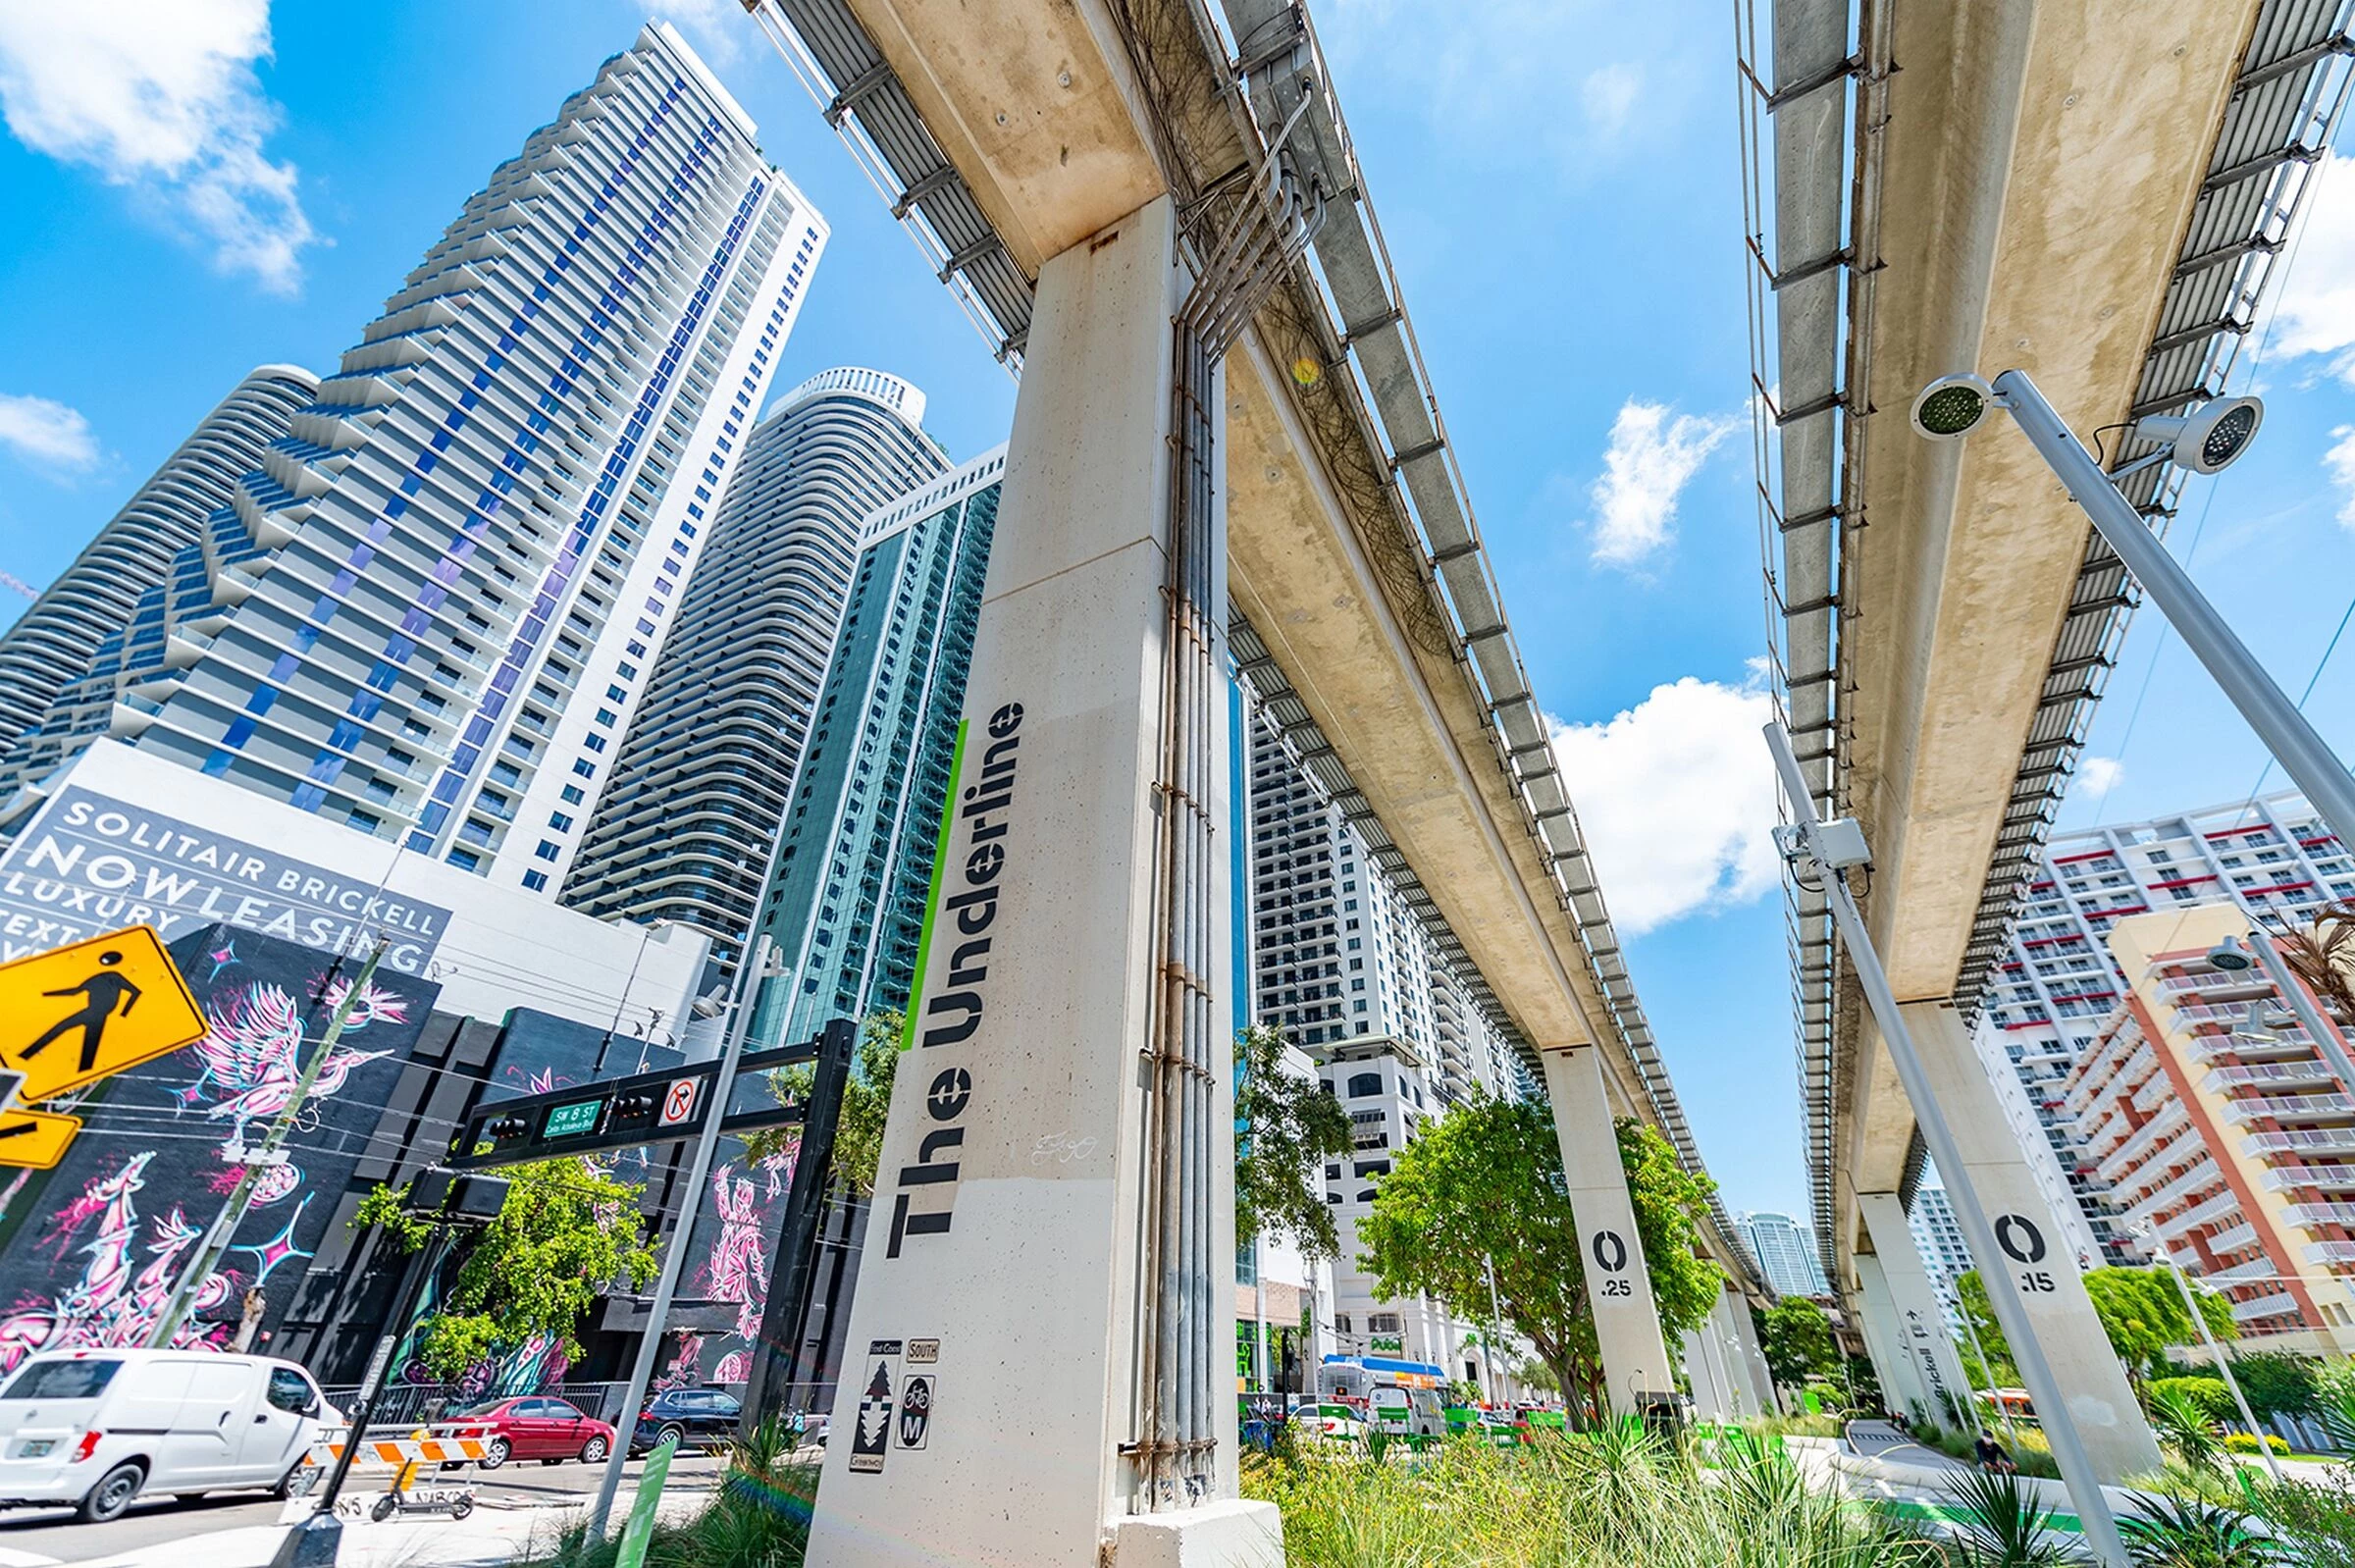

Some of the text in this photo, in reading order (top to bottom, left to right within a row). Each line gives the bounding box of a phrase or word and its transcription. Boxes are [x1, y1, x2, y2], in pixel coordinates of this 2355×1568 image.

[63, 801, 434, 937] SOLITAIR BRICKELL
[4, 871, 182, 932] LUXURY
[25, 834, 425, 973] NOW LEASING
[886, 702, 1024, 1259] The Underline
[570, 1107, 581, 1121] 8
[582, 1105, 596, 1119] ST
[1601, 1280, 1632, 1296] .25
[908, 1342, 938, 1358] SOUTH
